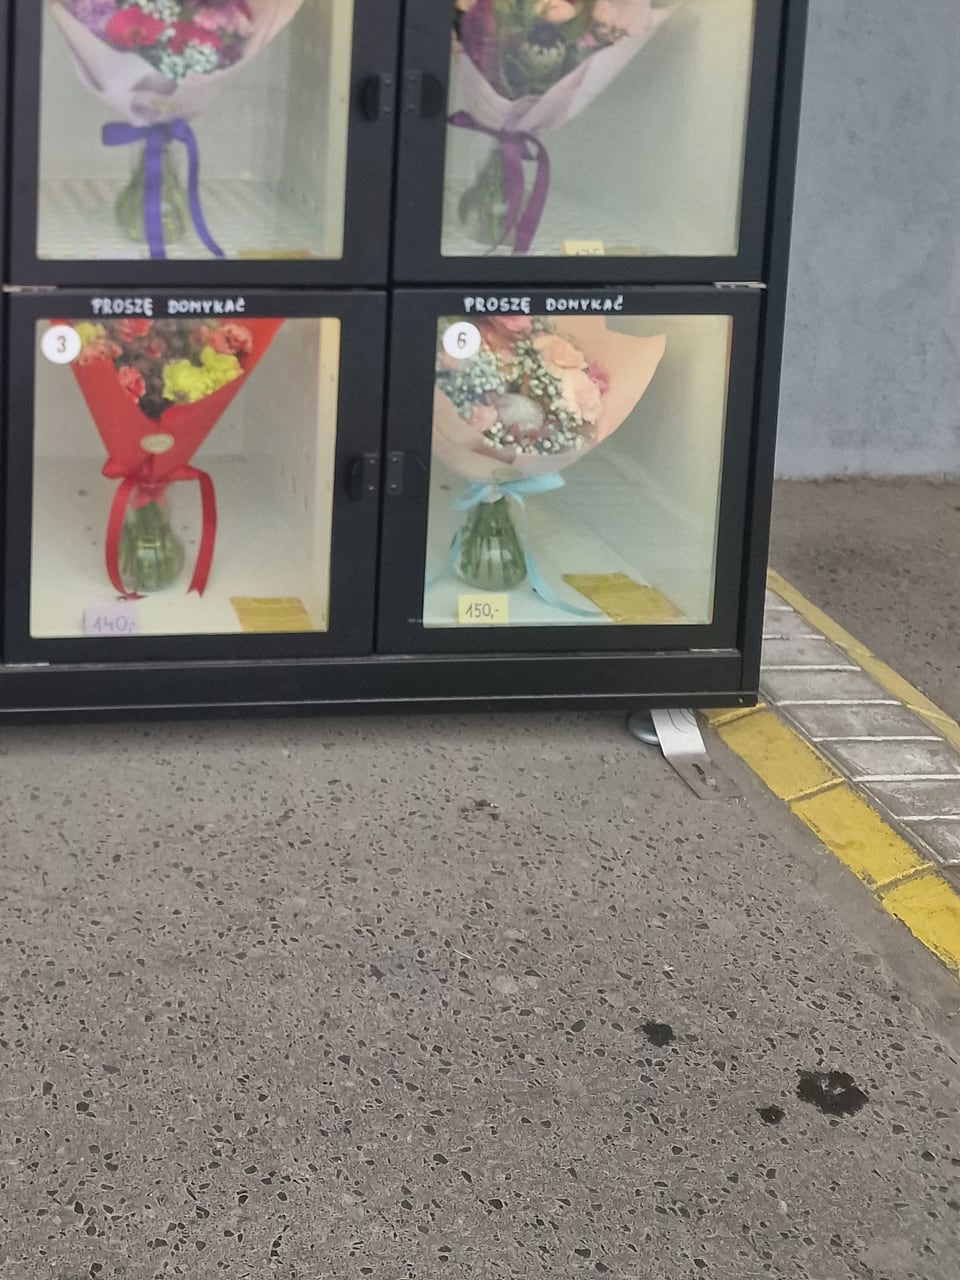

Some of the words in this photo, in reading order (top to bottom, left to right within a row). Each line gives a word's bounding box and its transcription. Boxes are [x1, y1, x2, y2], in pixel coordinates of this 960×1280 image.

[91, 297, 153, 317] PROSZĘ
[167, 296, 246, 315] DOMYKAĆ
[463, 296, 531, 314] PROSZĘ
[545, 294, 624, 312] DOMYKAĆ
